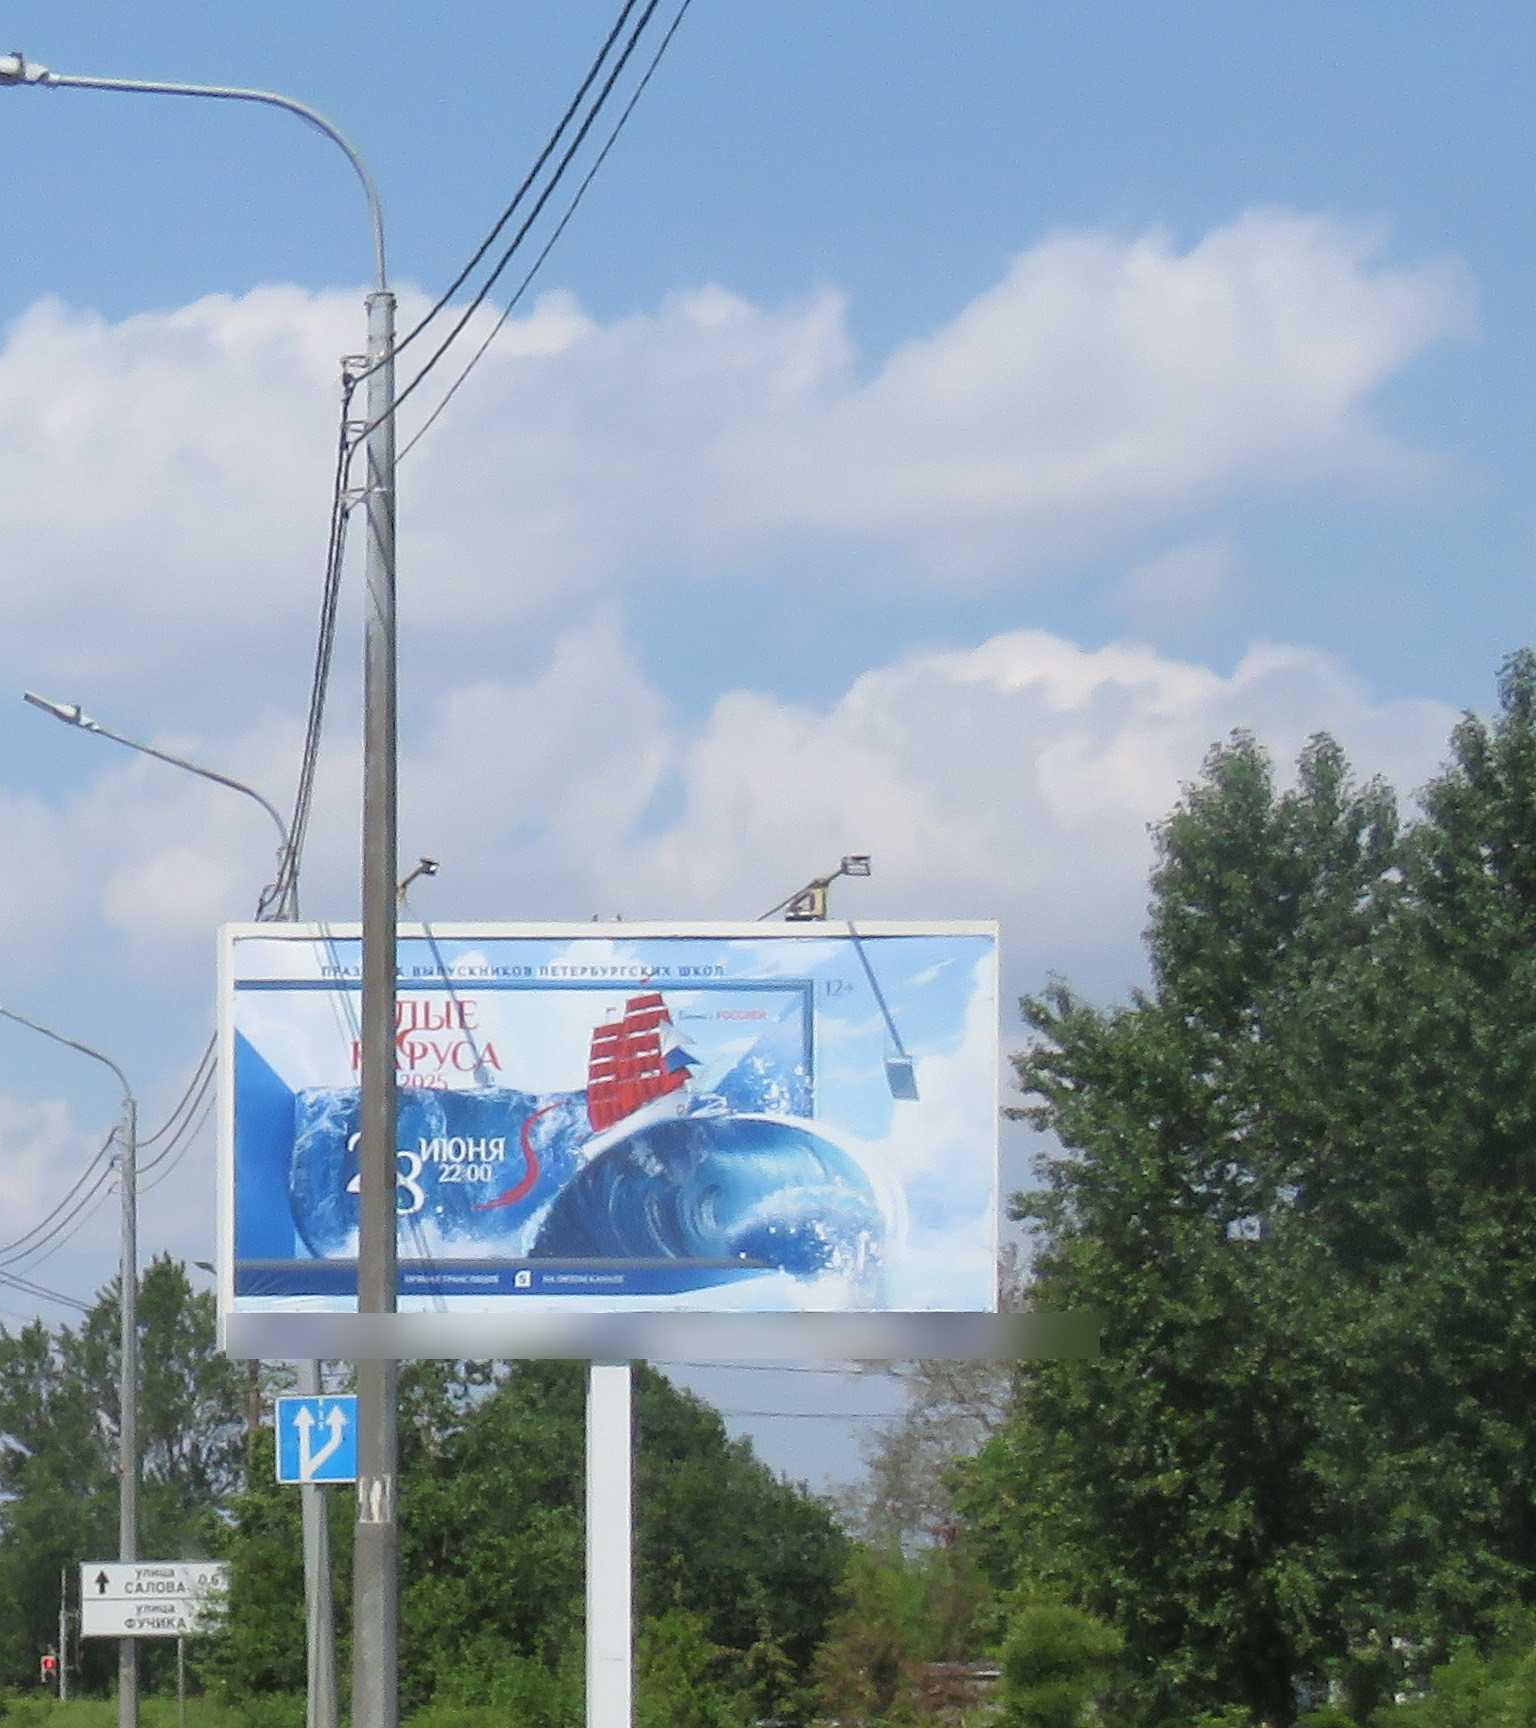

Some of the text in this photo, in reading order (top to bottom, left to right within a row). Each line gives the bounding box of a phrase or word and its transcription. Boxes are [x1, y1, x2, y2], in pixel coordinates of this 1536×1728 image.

[413, 966, 532, 977] ВЫПУСКНИКОВ
[539, 966, 671, 977] ПЕТЕРБУРГСКИХ
[679, 966, 725, 977] ШКОЛ
[395, 1001, 478, 1031] ЛЫЕ
[399, 1073, 448, 1090] 2025
[419, 1137, 505, 1163] ИЮНЯ
[135, 1568, 175, 1579] улица
[124, 1581, 185, 1594] САЛОВА
[135, 1604, 176, 1615] улица
[124, 1617, 187, 1630] ФУЧИКА
